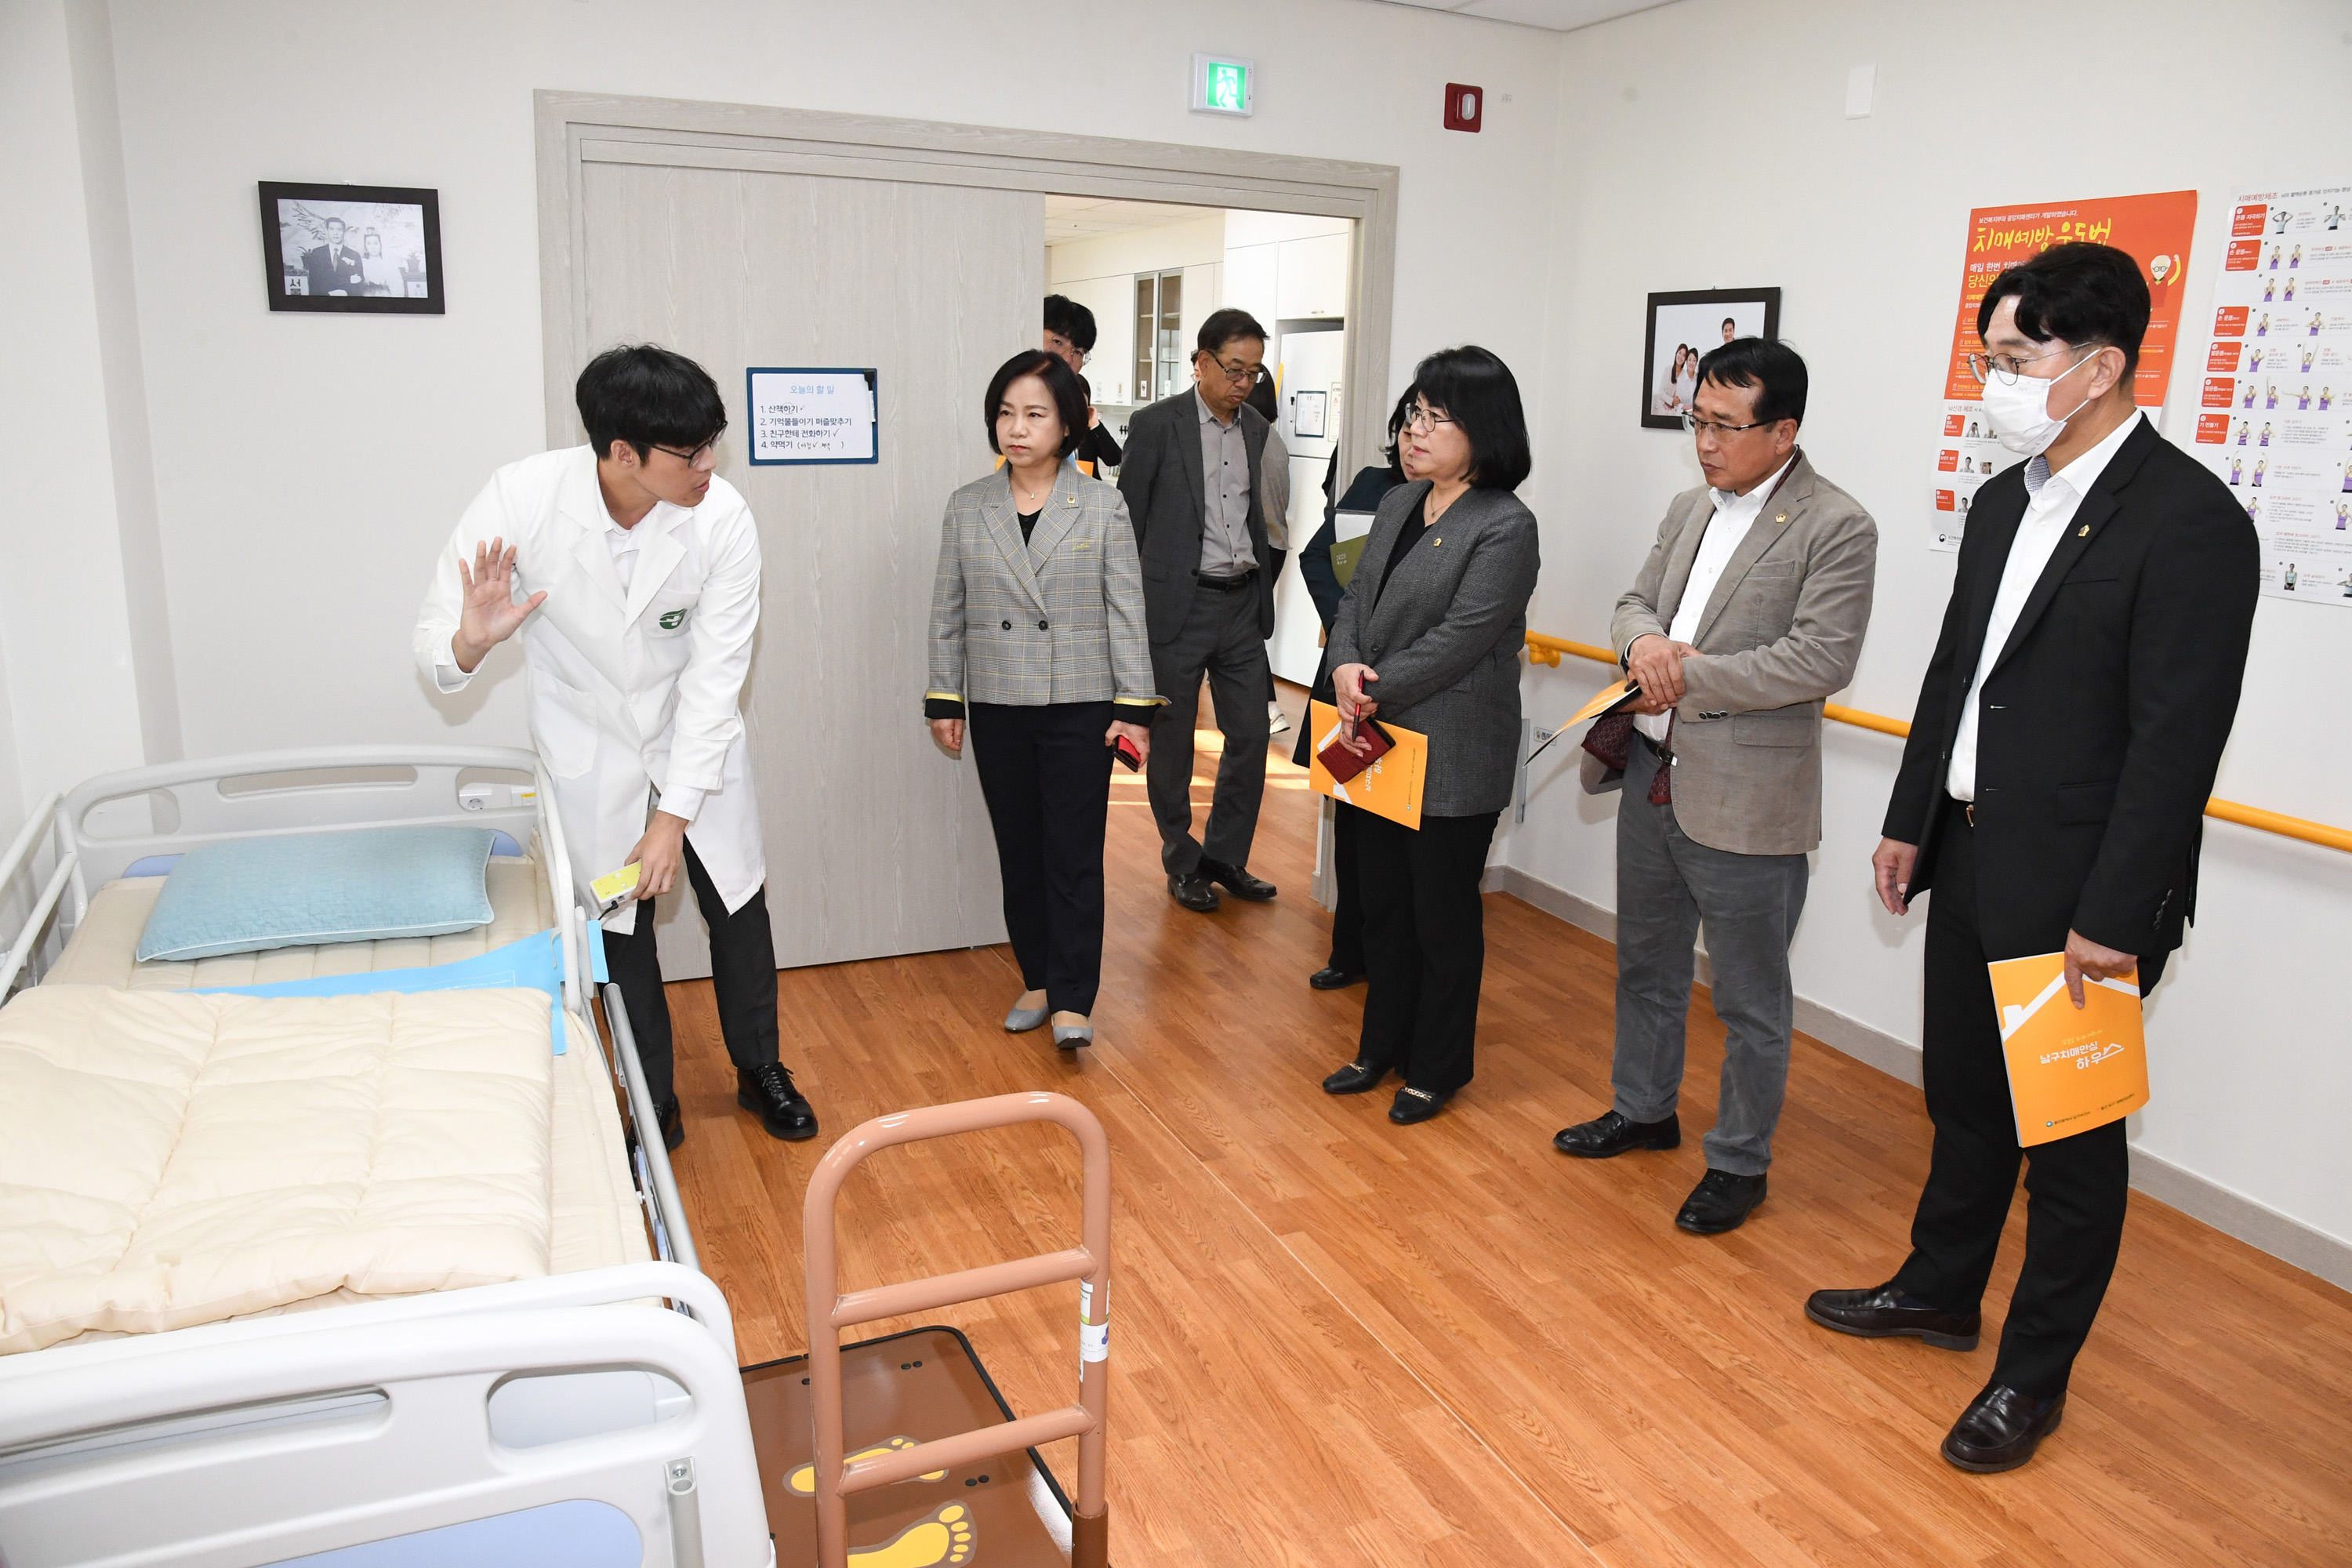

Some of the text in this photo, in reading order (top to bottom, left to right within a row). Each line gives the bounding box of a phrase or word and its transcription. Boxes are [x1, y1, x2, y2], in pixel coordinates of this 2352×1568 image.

[2238, 192, 2278, 203] 치매예방체조
[1969, 263, 1984, 272] 매일
[1986, 262, 2001, 272] 한번
[790, 385, 834, 394] 오늘의 할 일
[768, 405, 798, 414] 산책하기
[760, 430, 768, 438] 3.
[760, 441, 768, 449] 4.
[2039, 1040, 2099, 1065] 남구치매안심
[2075, 1042, 2125, 1070] 하우스
